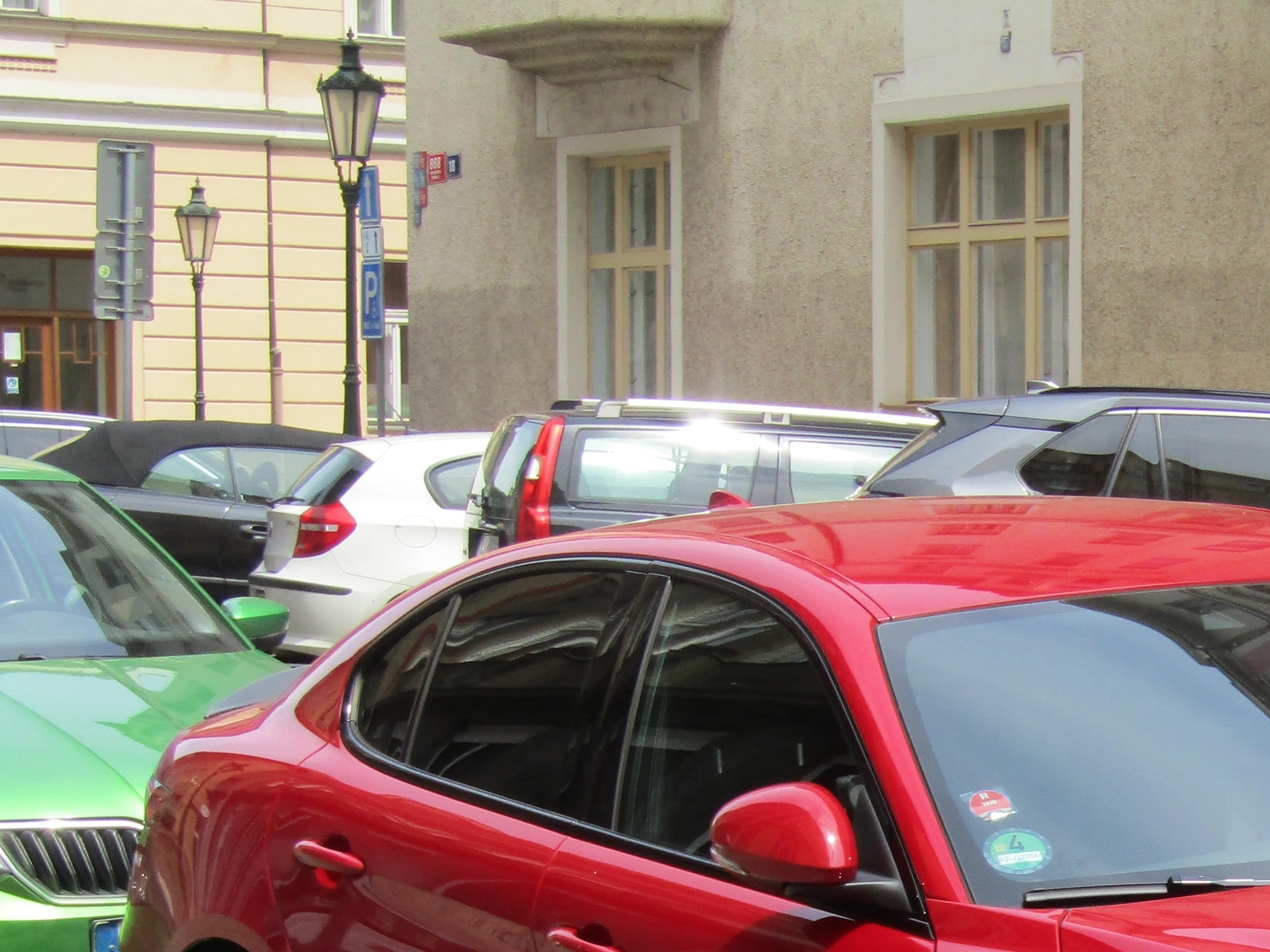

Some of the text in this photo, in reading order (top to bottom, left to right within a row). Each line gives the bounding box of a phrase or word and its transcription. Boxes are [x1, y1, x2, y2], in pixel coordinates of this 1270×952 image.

[365, 271, 378, 314] P
[979, 792, 990, 800] R
[1009, 834, 1025, 851] 4
